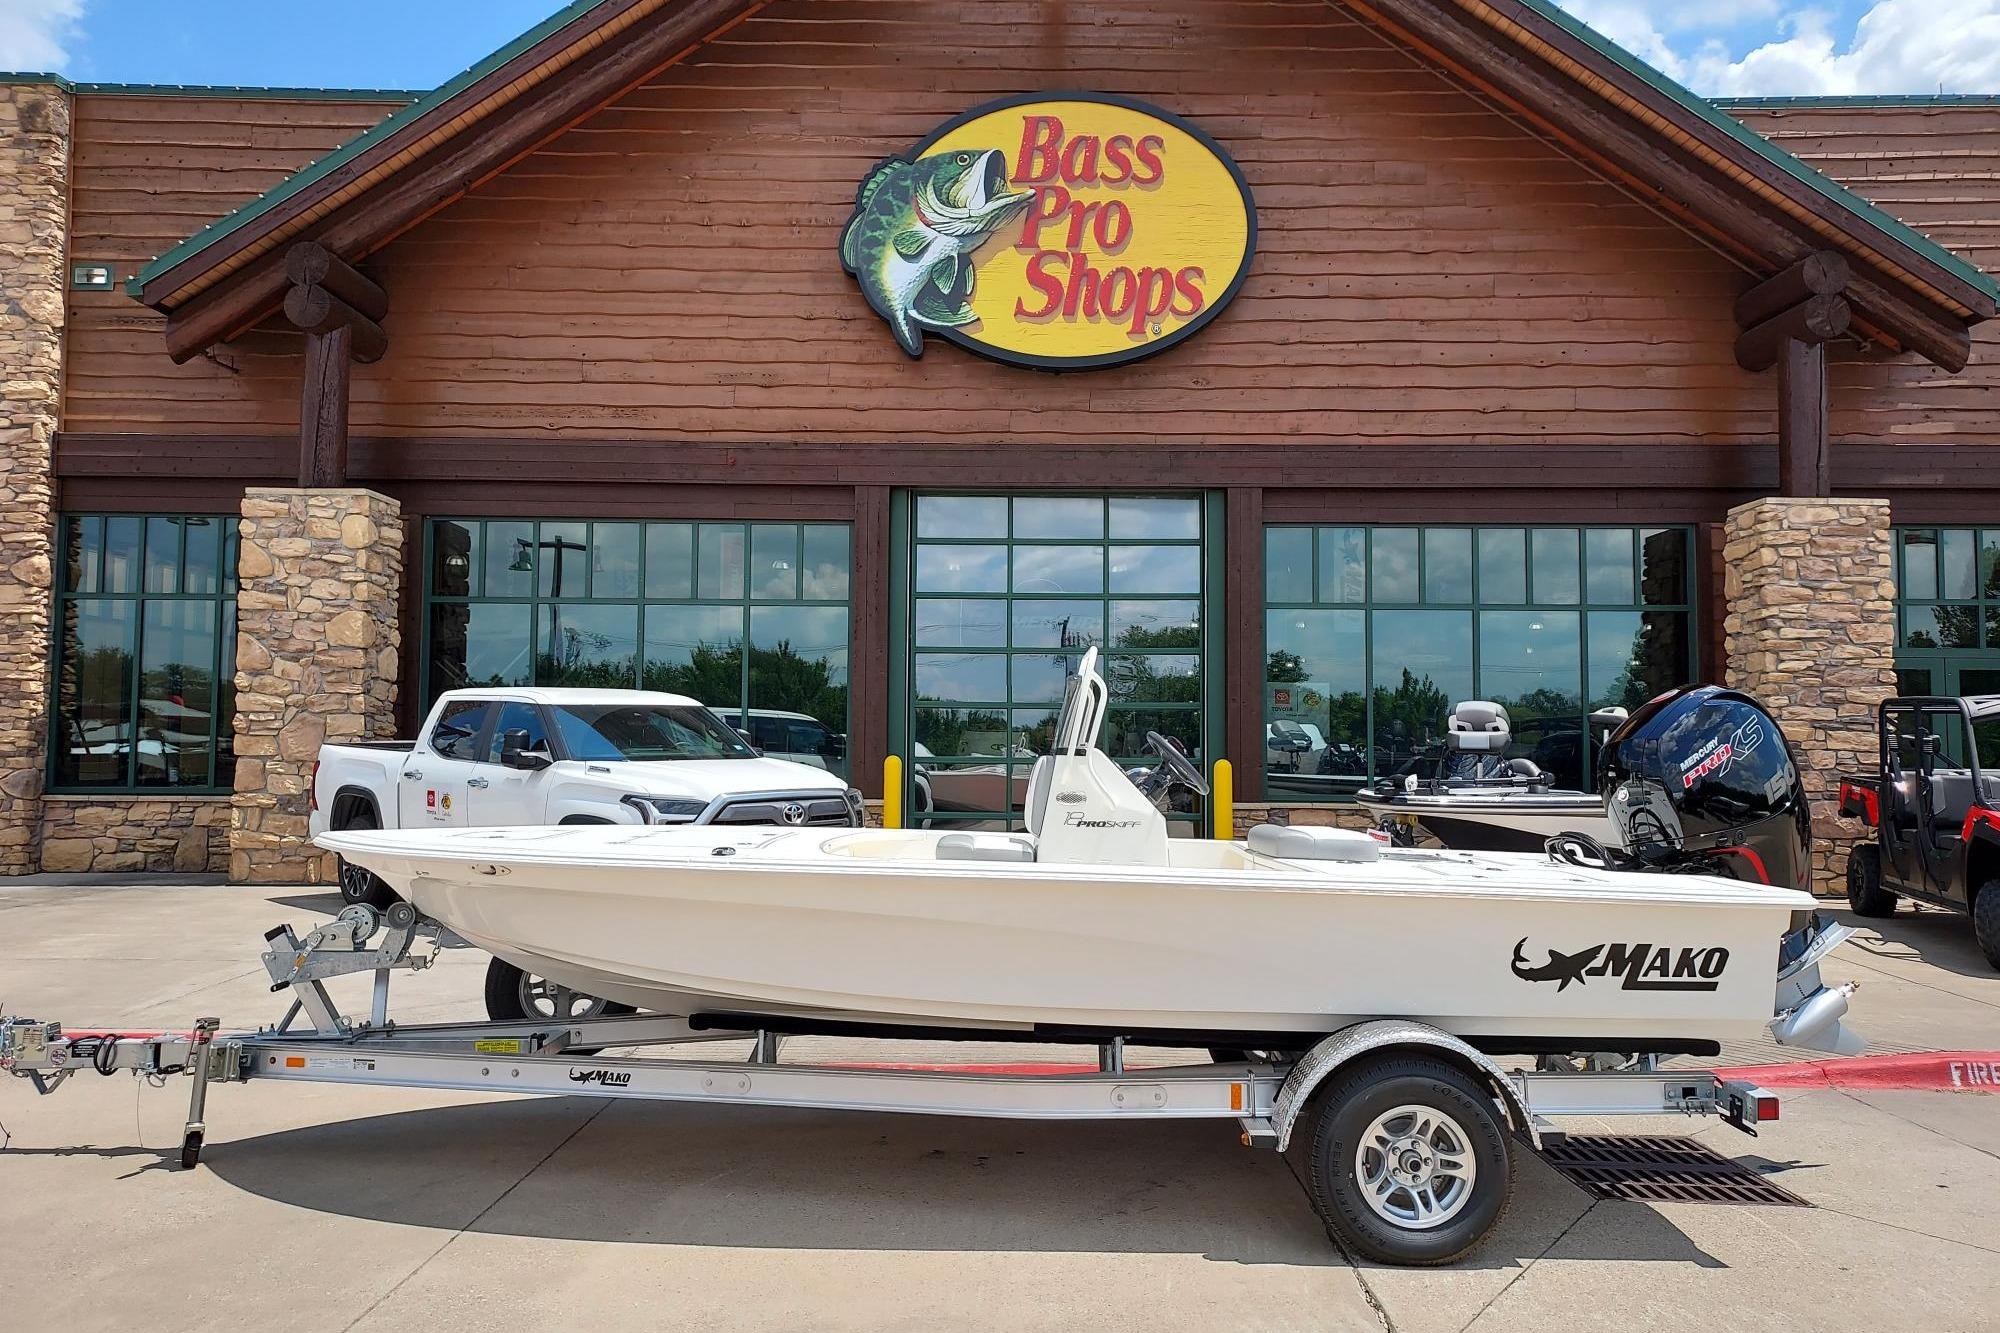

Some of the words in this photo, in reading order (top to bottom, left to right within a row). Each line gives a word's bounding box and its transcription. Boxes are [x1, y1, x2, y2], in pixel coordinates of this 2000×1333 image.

[1010, 115, 1164, 183] Bass
[1016, 185, 1132, 250] Pro
[1015, 251, 1205, 335] Shops
[1680, 737, 1720, 771] MERCURY
[1682, 743, 1732, 788] PRO
[1718, 714, 1764, 778] XS
[1763, 762, 1796, 805] 150
[1584, 943, 1730, 991] MAKO
[590, 1070, 631, 1087] MAKO
